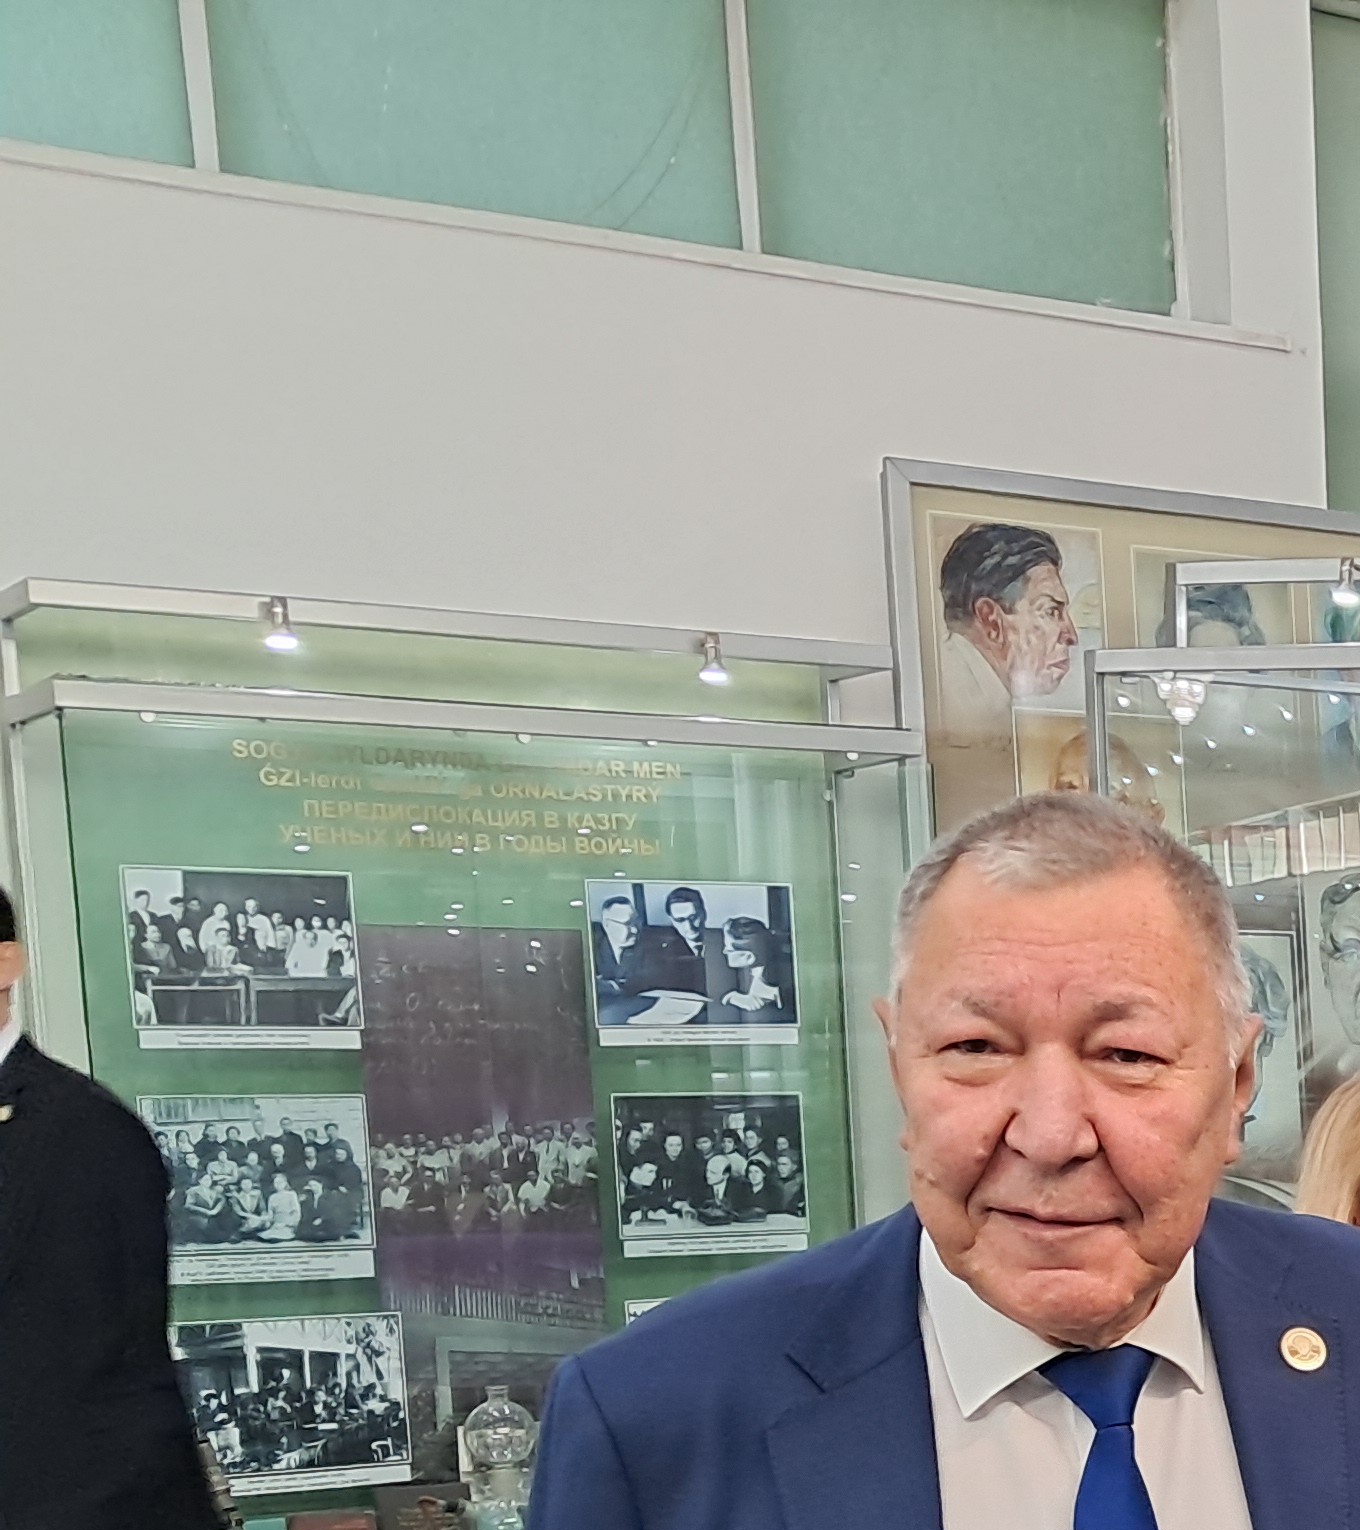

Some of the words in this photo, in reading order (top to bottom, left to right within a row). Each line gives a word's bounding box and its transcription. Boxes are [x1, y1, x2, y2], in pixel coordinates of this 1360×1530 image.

[633, 760, 681, 779] MEN
[303, 798, 537, 830] ПЕРЕДИСЛОКАЦИЯ
[544, 811, 559, 829] В
[567, 813, 637, 832] КАЗГУ
[279, 823, 388, 847] УЧЕНЫХ
[398, 831, 412, 849] И
[476, 833, 491, 853] В
[500, 834, 567, 855] ГОДЫ
[575, 832, 660, 857] ВОЙНЫ
